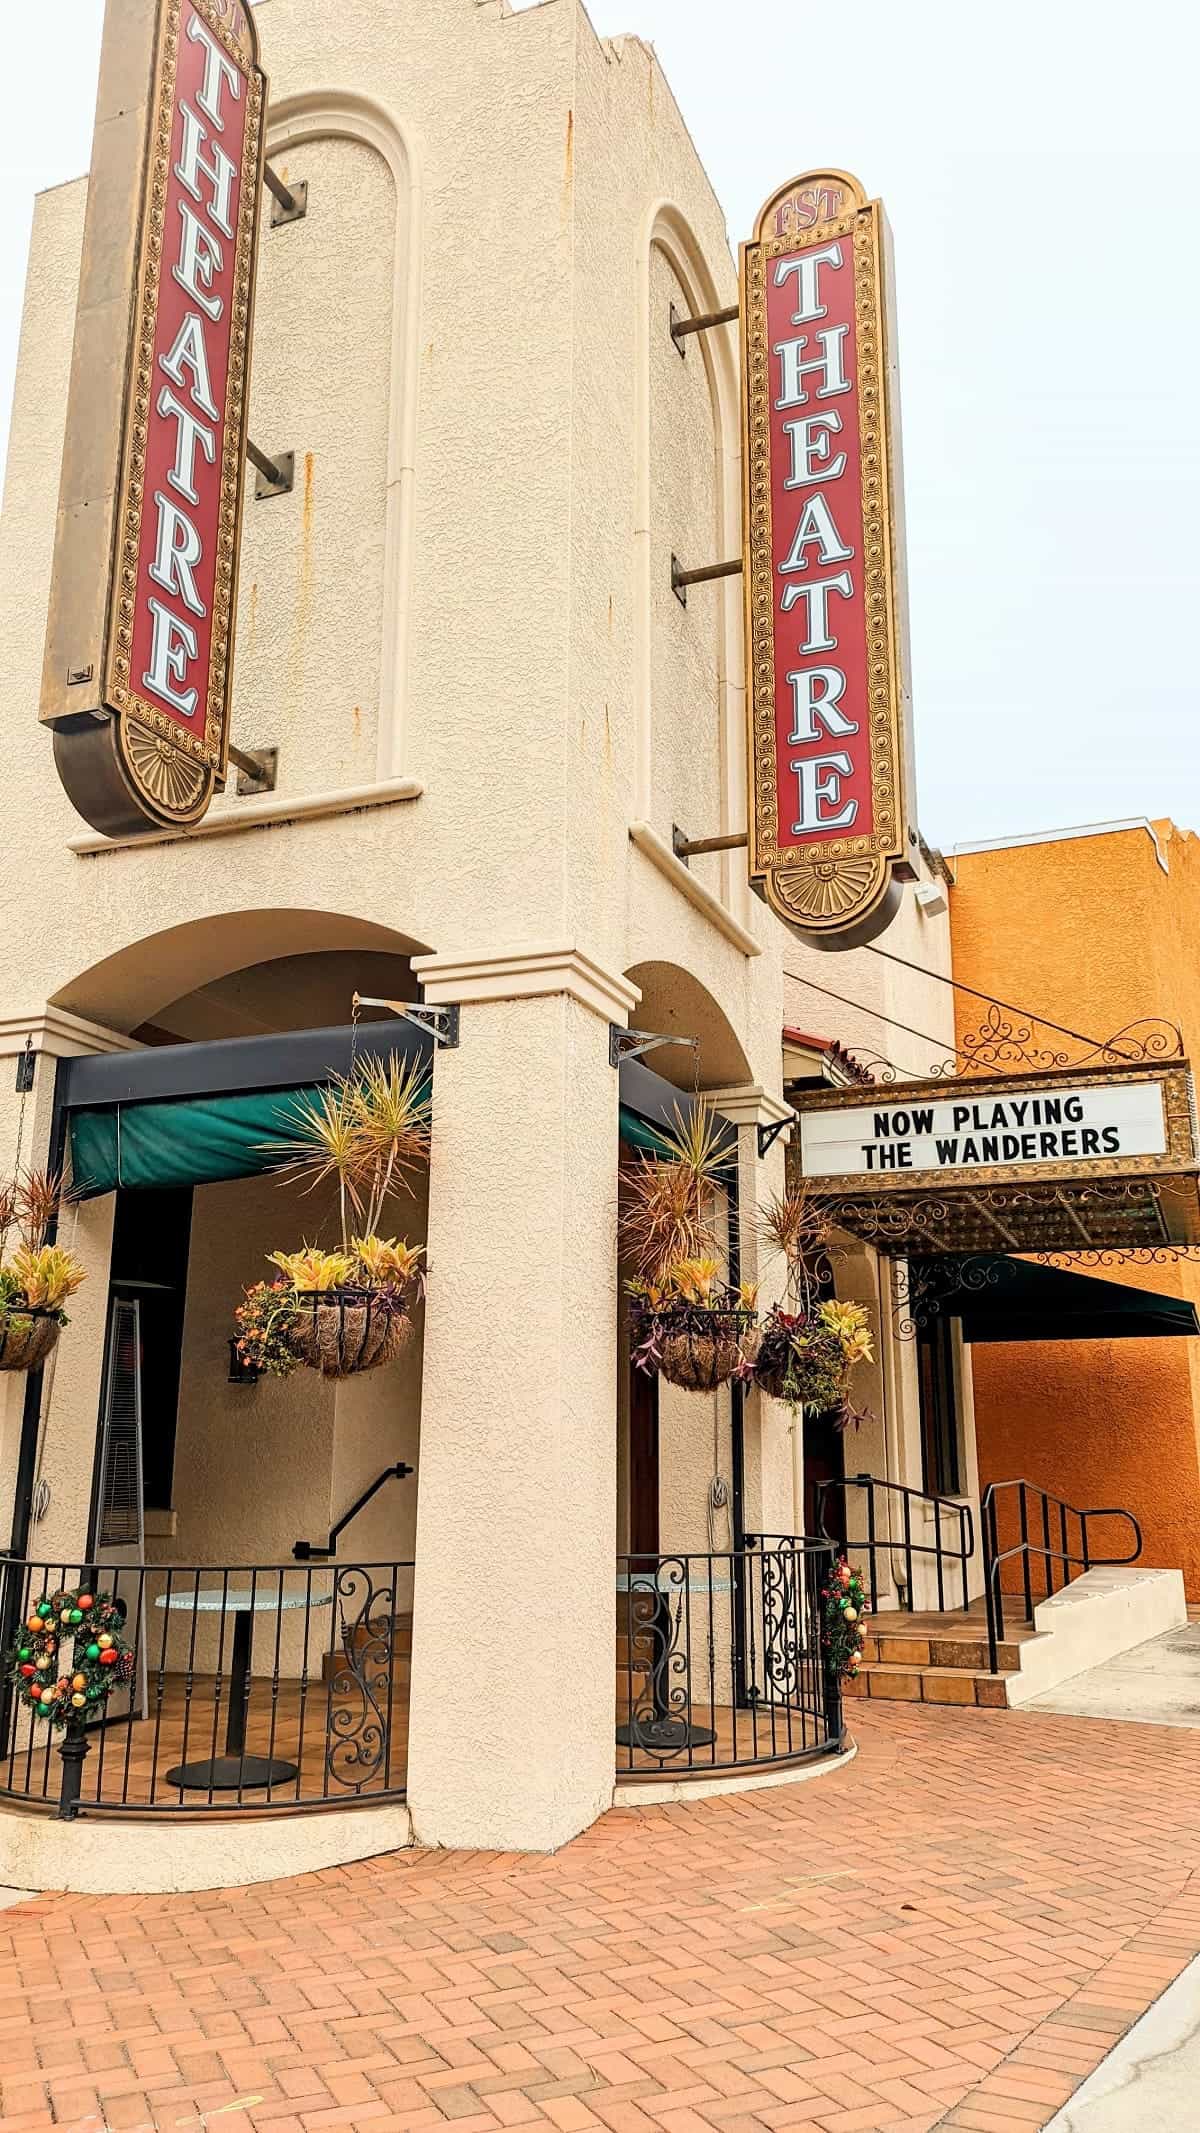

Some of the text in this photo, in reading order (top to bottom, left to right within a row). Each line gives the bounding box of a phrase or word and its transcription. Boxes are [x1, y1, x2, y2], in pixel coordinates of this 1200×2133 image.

[774, 186, 842, 238] FST
[142, 10, 240, 716] THEATRE
[772, 242, 859, 835] THEATRE
[873, 1096, 1084, 1138] NOW PLAYING
[861, 1126, 1120, 1170] THE WANDERERS
